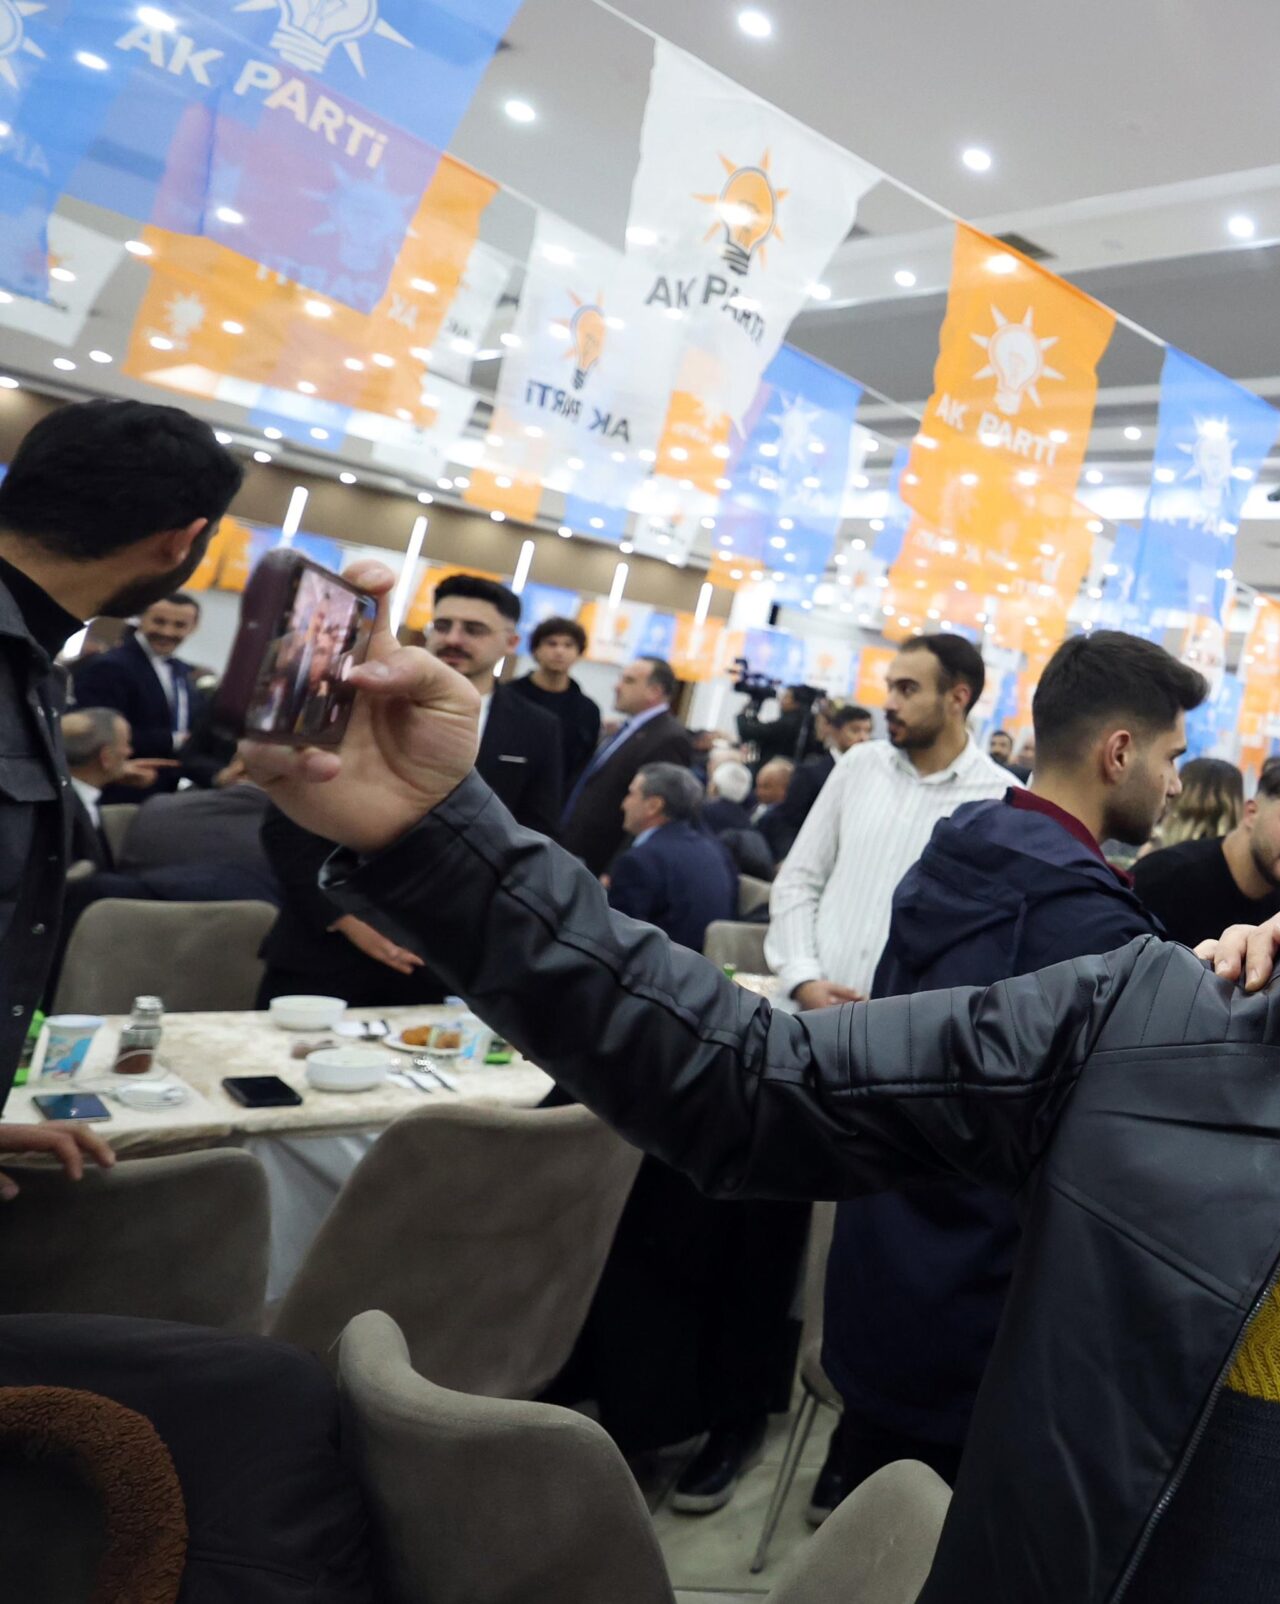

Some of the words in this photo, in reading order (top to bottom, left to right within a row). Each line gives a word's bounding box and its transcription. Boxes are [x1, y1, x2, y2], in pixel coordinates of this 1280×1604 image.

[114, 22, 224, 87] AK
[643, 274, 698, 308] AK
[935, 393, 968, 432] AK
